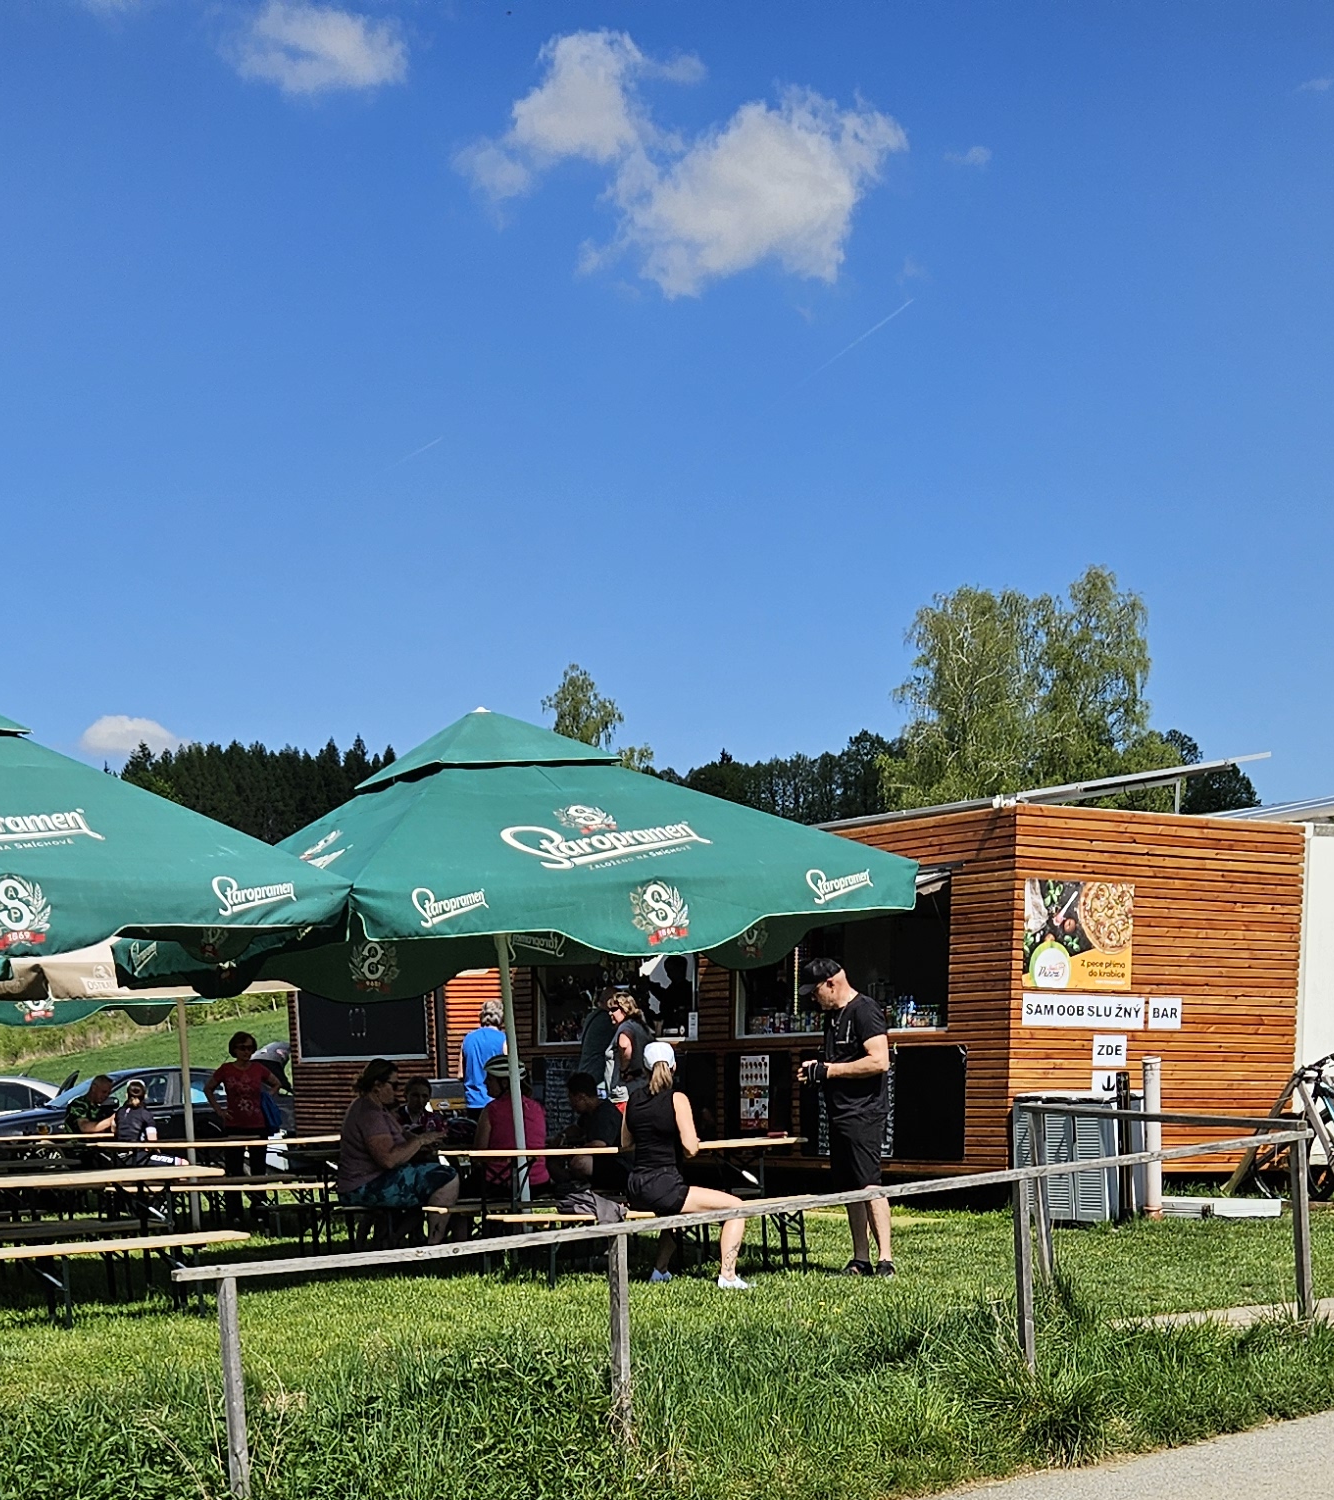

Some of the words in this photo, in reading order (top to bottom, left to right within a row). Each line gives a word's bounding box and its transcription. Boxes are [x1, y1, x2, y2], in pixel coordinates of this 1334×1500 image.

[500, 822, 713, 870] Staropramen
[211, 876, 297, 916] Staropramen
[806, 869, 874, 904] Staropramen
[411, 887, 490, 928] Staropramen
[7, 930, 31, 941] 1869
[1086, 961, 1104, 969] pece
[1152, 1007, 1178, 1019] BAR
[1097, 1044, 1123, 1056] ZDE
